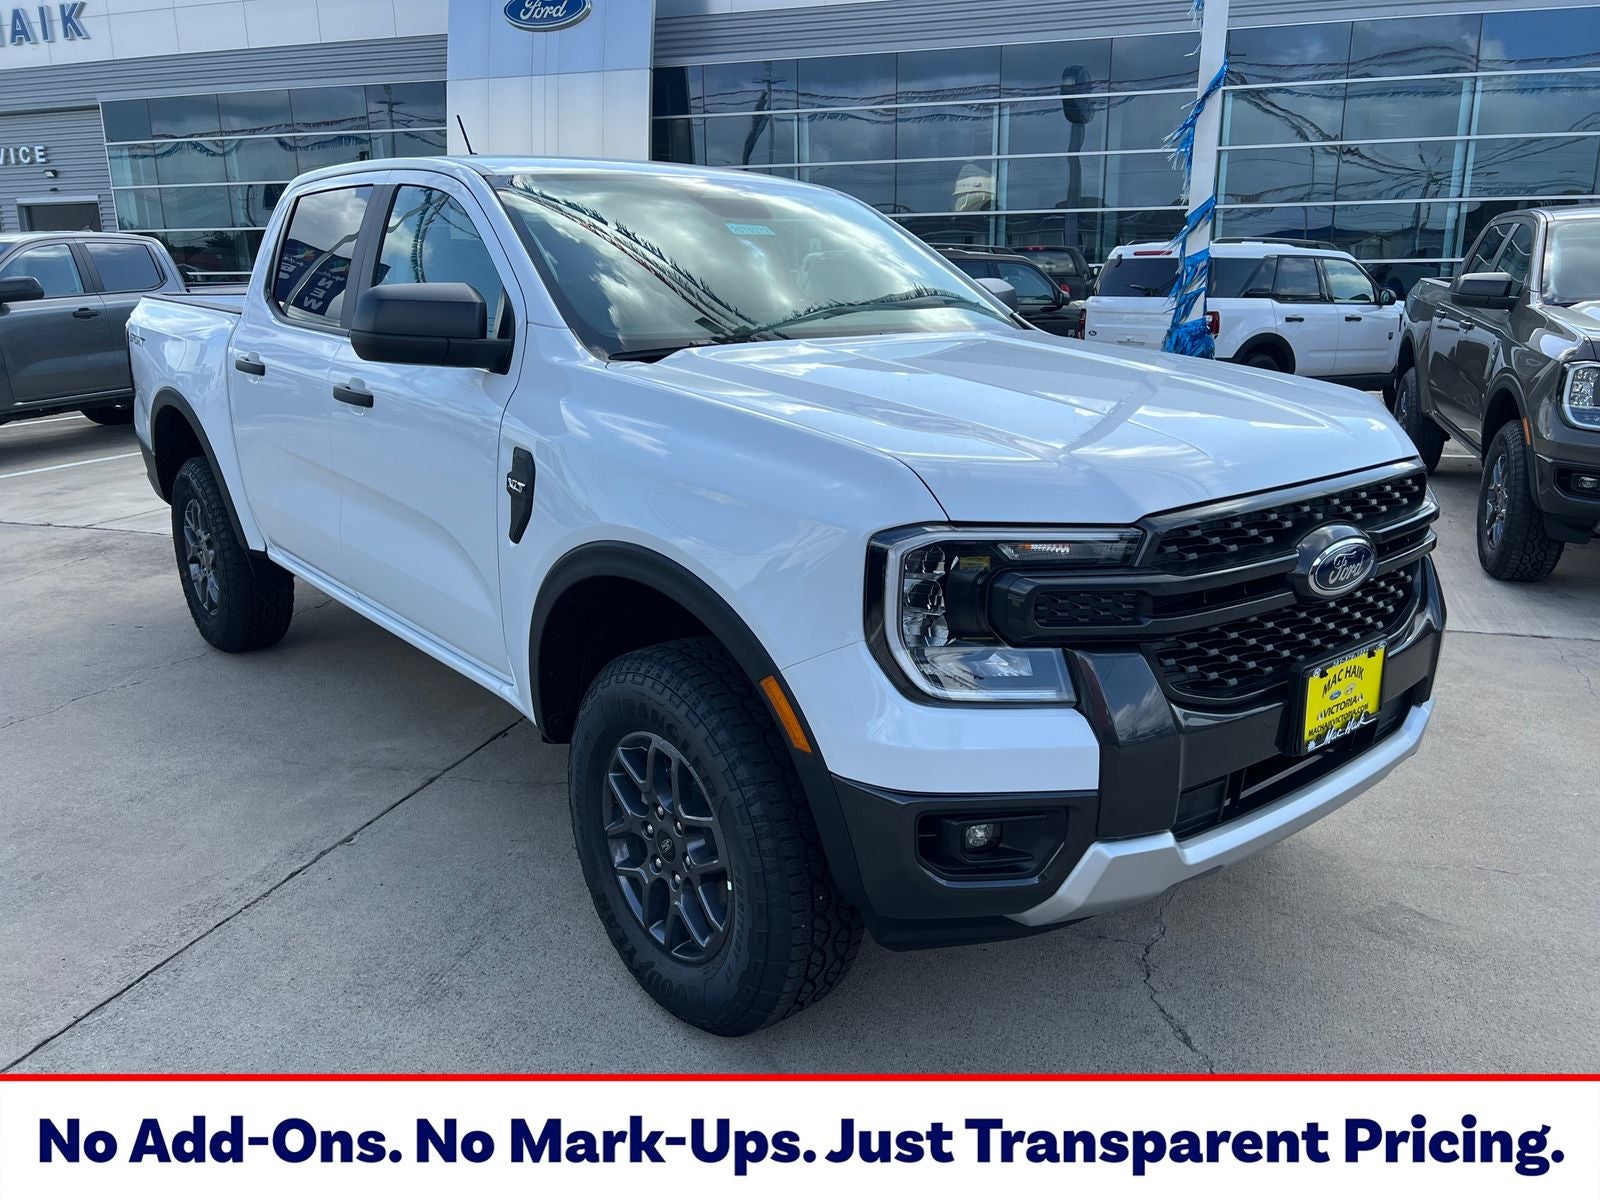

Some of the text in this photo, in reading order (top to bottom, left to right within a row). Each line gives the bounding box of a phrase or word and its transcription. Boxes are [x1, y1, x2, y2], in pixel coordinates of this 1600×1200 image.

[0, 1, 91, 47] AIK
[520, 0, 567, 20] Ford
[1328, 550, 1366, 585] Ford
[1322, 664, 1365, 699] MAC HAIK
[1322, 694, 1358, 719] VICTORIA
